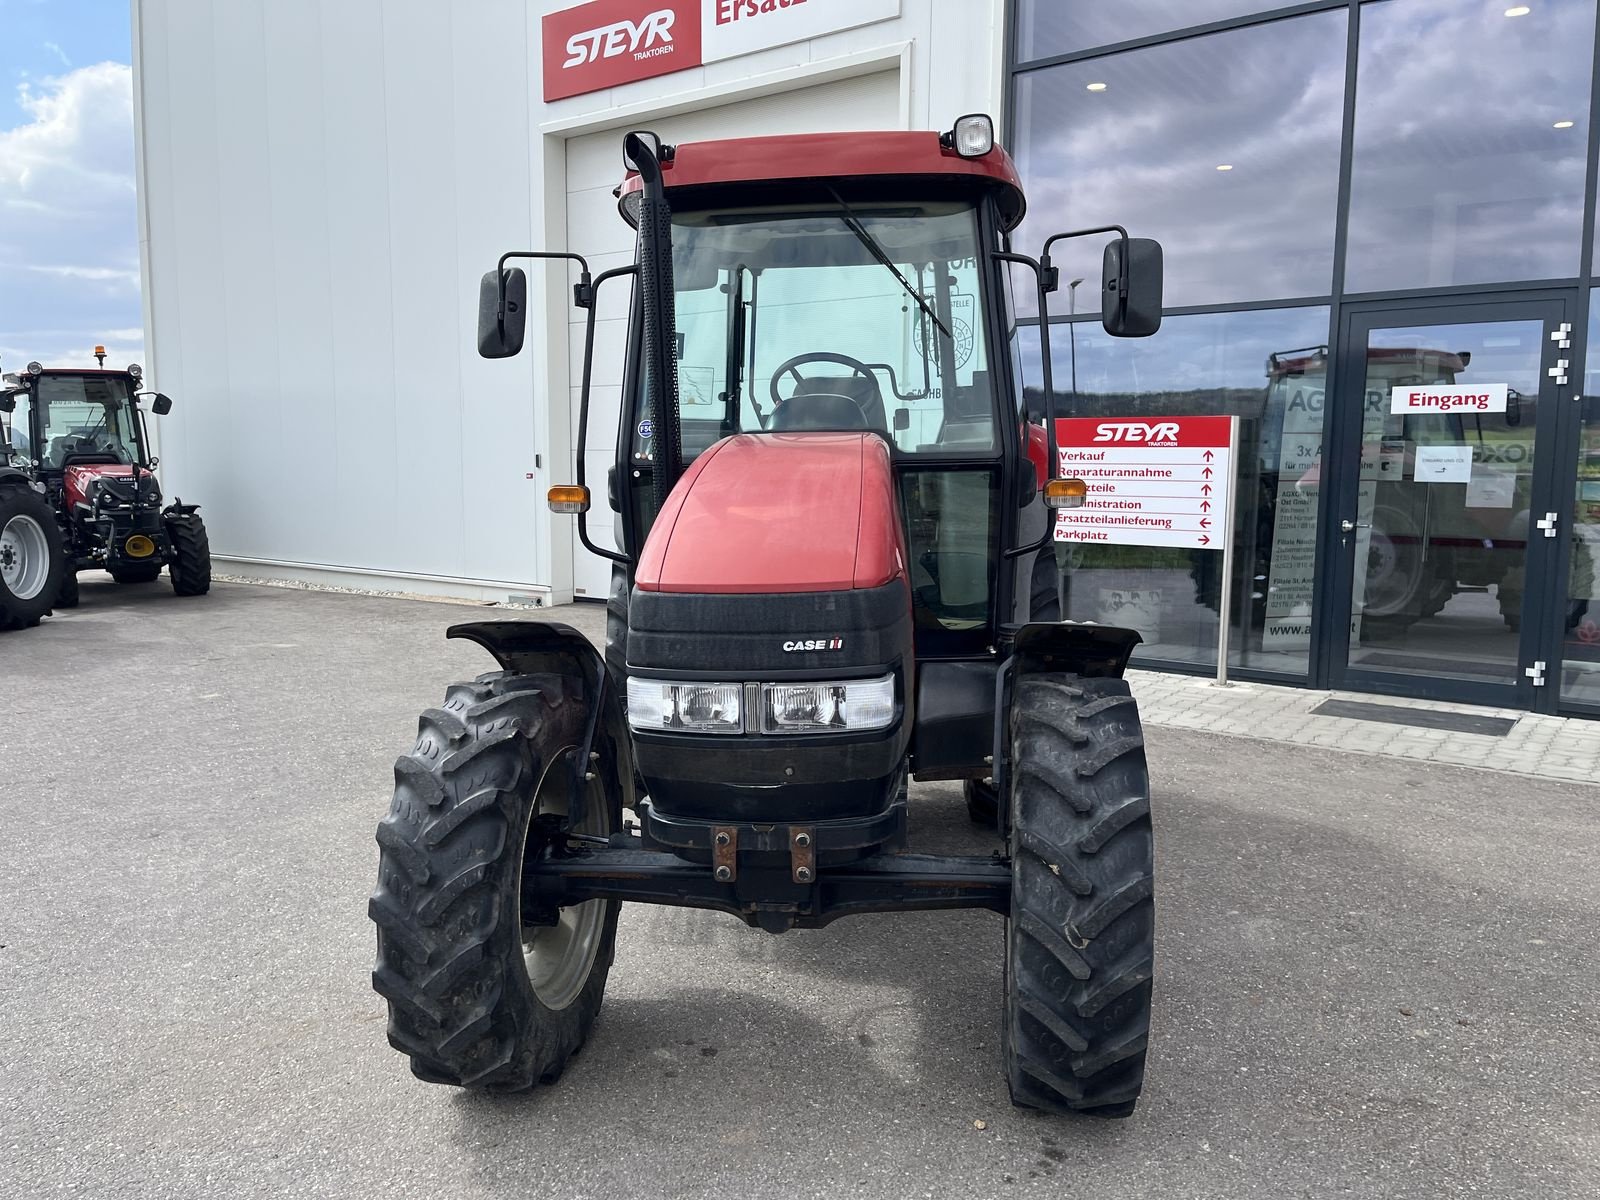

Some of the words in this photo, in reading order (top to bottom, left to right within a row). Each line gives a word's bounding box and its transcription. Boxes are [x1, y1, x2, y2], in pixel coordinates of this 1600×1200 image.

[716, 0, 807, 25] Ersa
[562, 9, 675, 68] STEYR
[633, 44, 674, 61] TRAKTOREN
[1408, 393, 1490, 411] Eingang
[1093, 422, 1180, 442] STEYR
[1060, 452, 1105, 461] Verkauf
[1059, 467, 1172, 479] Reparaturannahme
[1086, 484, 1116, 493] zteile
[1080, 500, 1142, 510] inistration
[1057, 513, 1172, 529] Ersatzteilanlieferung
[1056, 529, 1108, 541] Parkplatz
[783, 640, 826, 652] CASE
